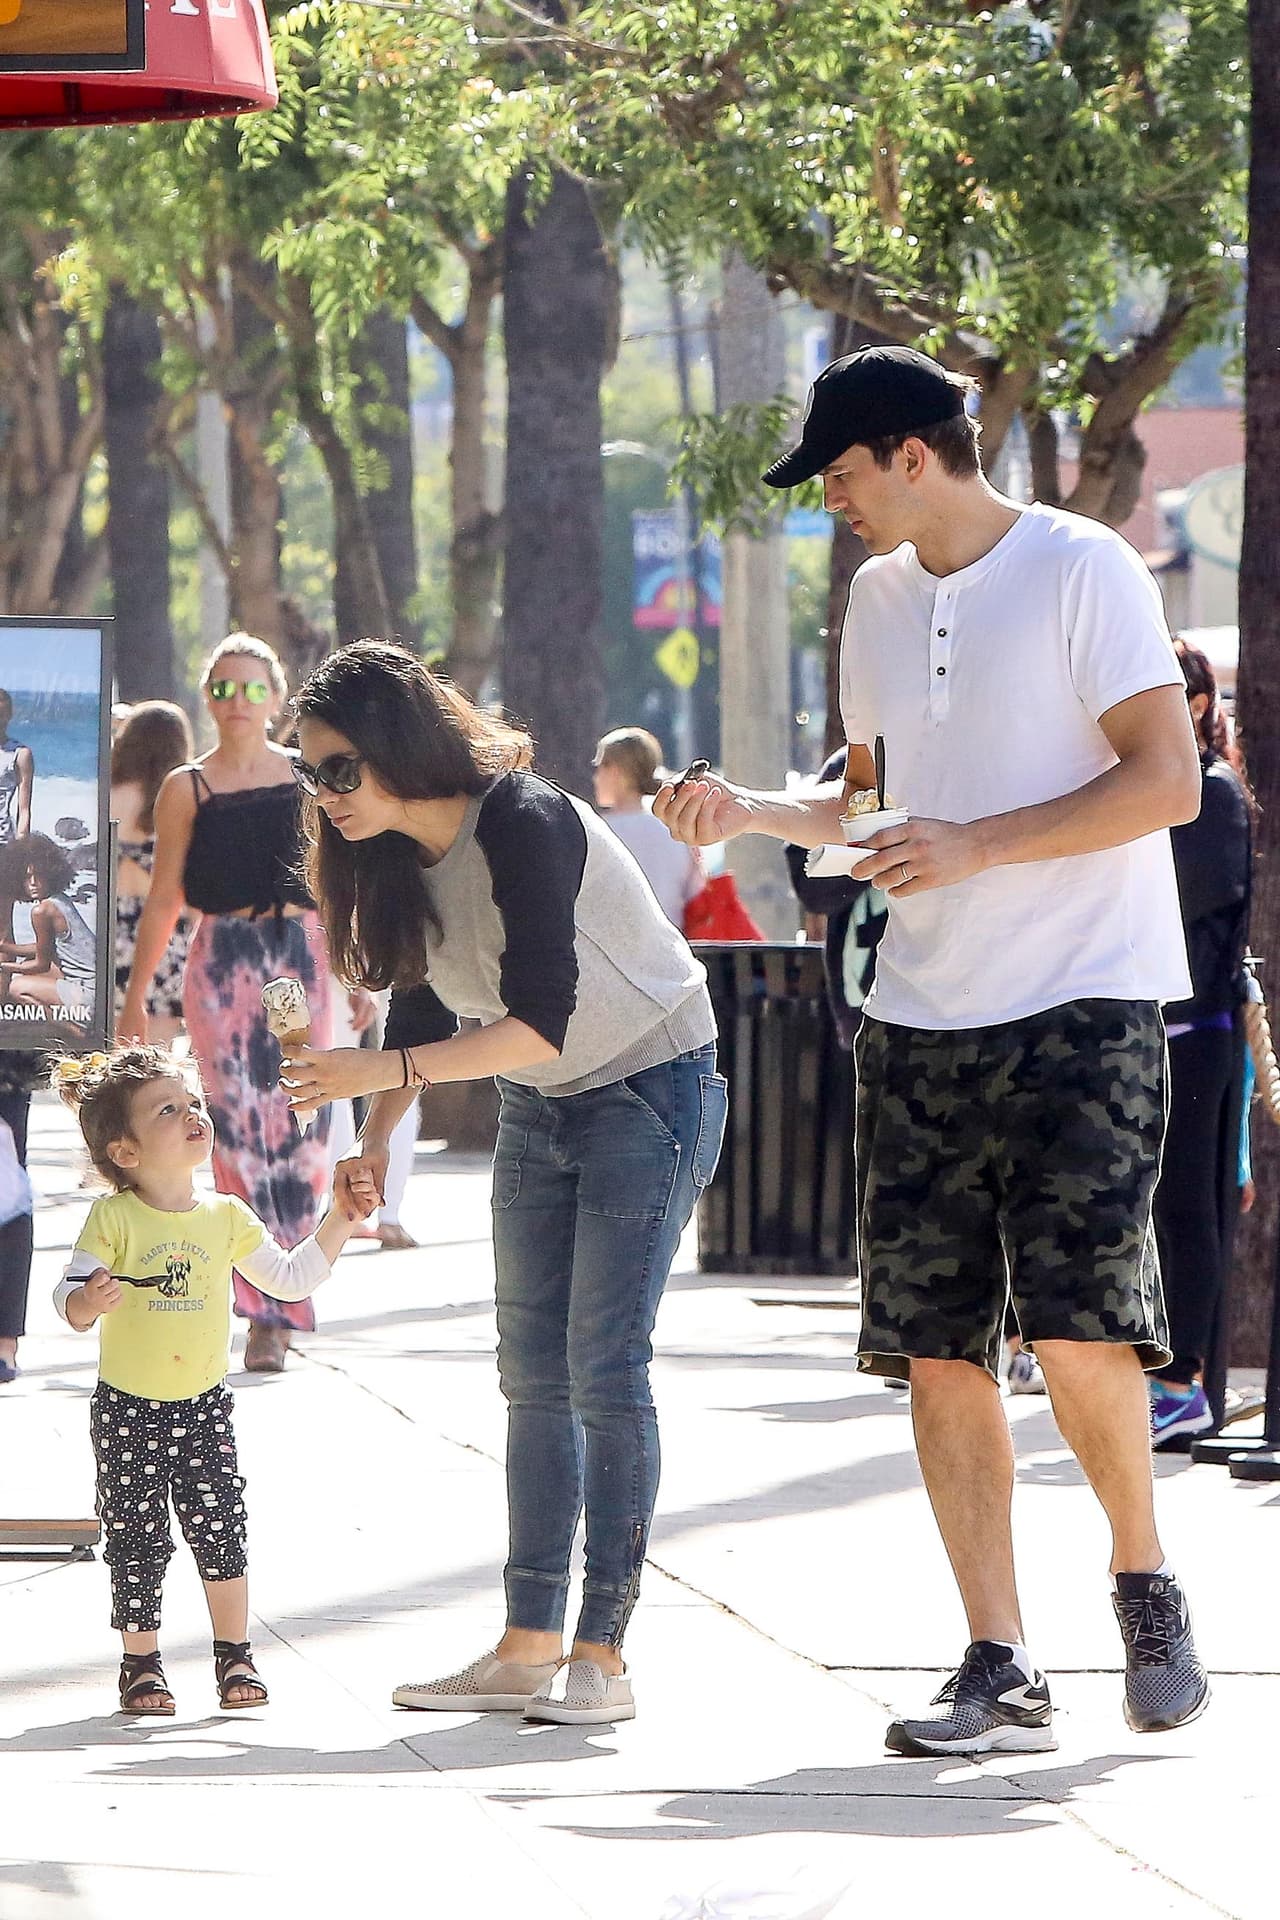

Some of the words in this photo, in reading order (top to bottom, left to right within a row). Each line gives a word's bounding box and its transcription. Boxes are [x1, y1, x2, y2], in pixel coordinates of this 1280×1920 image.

[50, 1004, 92, 1021] TANK
[140, 1241, 177, 1265] DADDY'S
[147, 1299, 205, 1312] PRINCESS
